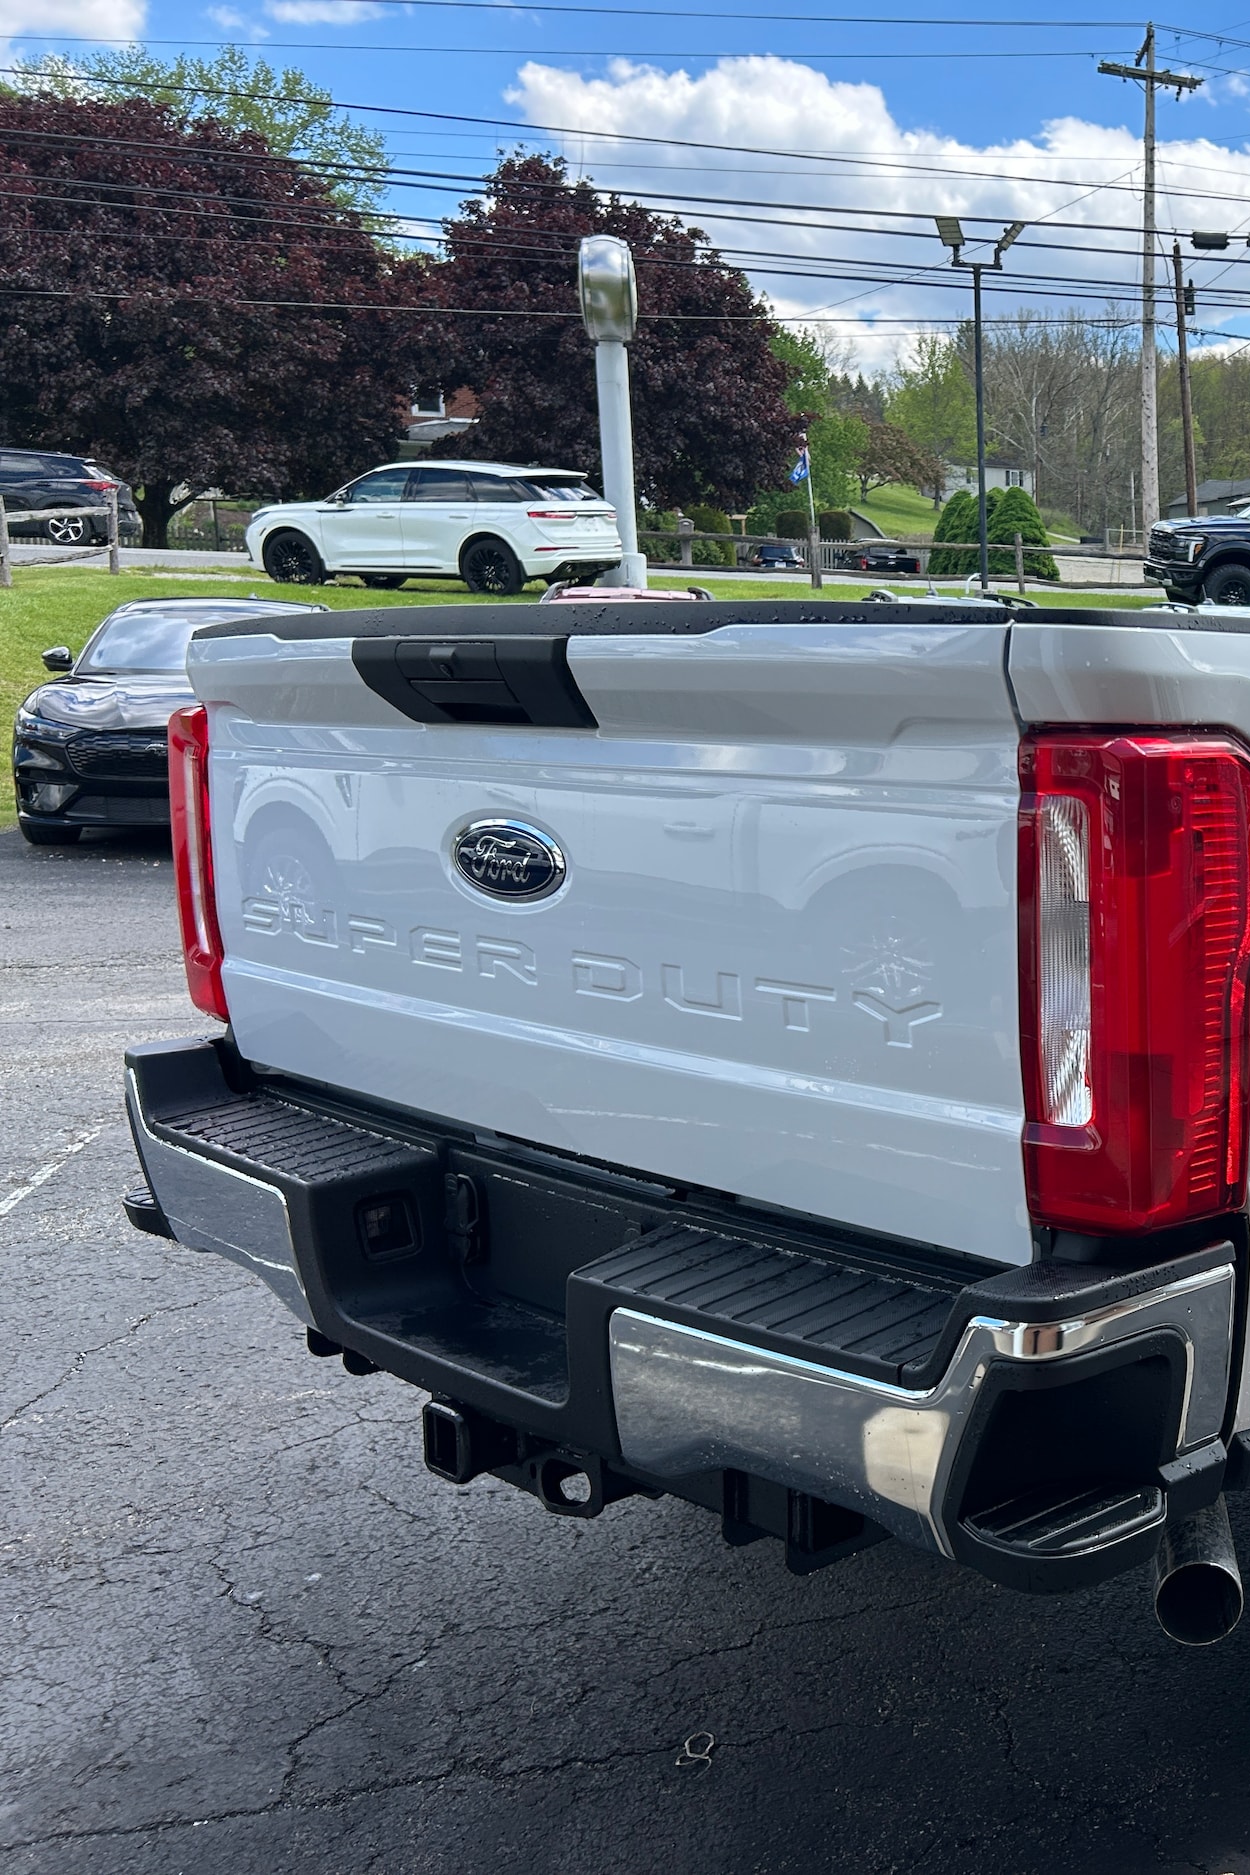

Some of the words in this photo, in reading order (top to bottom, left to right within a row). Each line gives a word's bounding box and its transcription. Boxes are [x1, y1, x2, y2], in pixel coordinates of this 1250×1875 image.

[470, 835, 532, 884] Ford
[241, 895, 539, 987] SUPER
[570, 949, 944, 1048] DUTY
